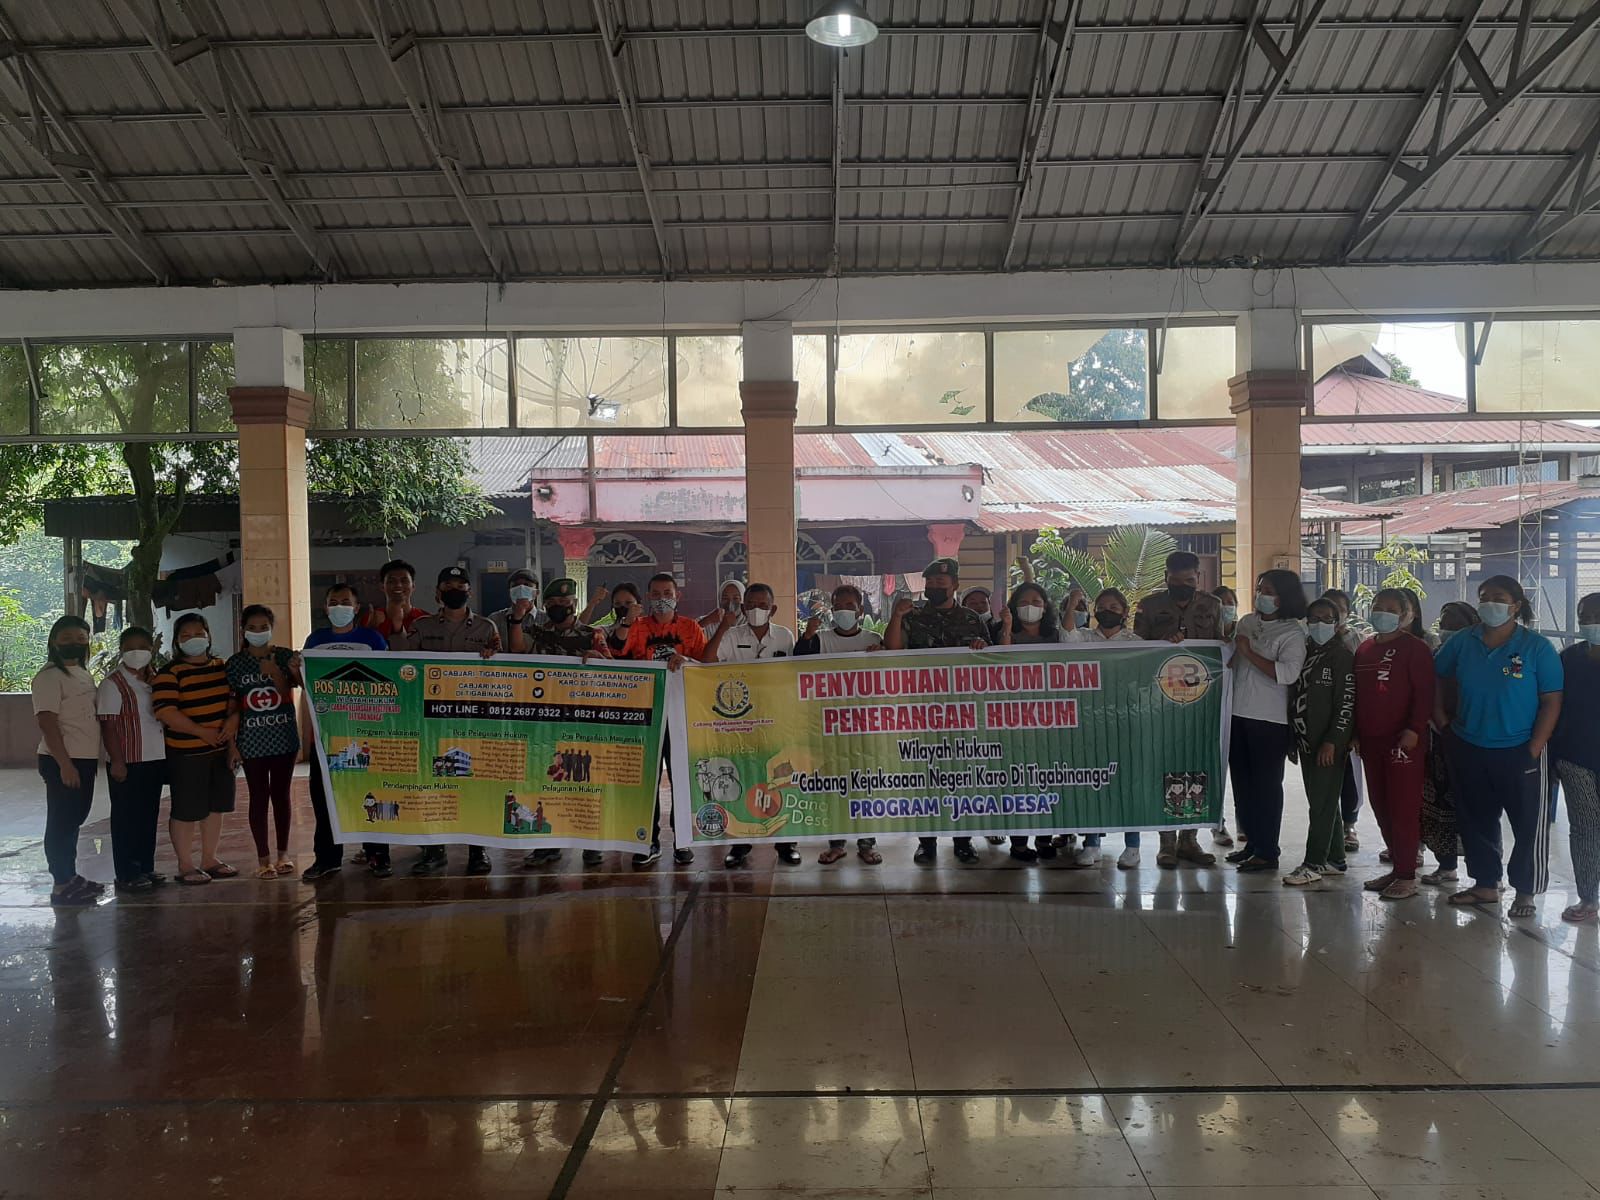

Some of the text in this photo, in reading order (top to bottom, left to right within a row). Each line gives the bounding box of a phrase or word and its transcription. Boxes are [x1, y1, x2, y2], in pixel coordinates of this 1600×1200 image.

[580, 672, 623, 680] KEJAKSAAN
[624, 674, 651, 682] NEGERI
[799, 664, 1099, 699] PENYULUHAN HUKUM DAN
[314, 681, 398, 697] POS JAGA DESA
[336, 696, 367, 704] WILAYAH
[1336, 673, 1356, 732] GIVENCHY
[246, 714, 288, 728] GUCCI
[432, 705, 454, 714] HOT
[456, 705, 478, 714] LINE
[489, 706, 511, 716] 0812
[514, 707, 535, 716] 2687
[538, 708, 560, 717] 9322
[574, 710, 596, 718] 0821
[599, 711, 620, 720] 4053
[622, 712, 645, 721] 2220
[824, 700, 1076, 734] PENERANGAN HUKUM
[356, 728, 386, 736] Program
[504, 731, 528, 739] Hukum
[899, 738, 1002, 764] Wilayah Hukum
[382, 781, 459, 792] Pendampingan Hukum
[792, 770, 847, 796] “Cabang
[850, 768, 926, 795] Kejaksaaan
[930, 765, 972, 792] Negeri
[976, 766, 1007, 786] Karo
[1012, 765, 1024, 786] Di
[542, 785, 576, 794] Pelayanan
[755, 789, 771, 812] Rp
[850, 794, 1058, 819] PROGRAM “JAGA DESA”
